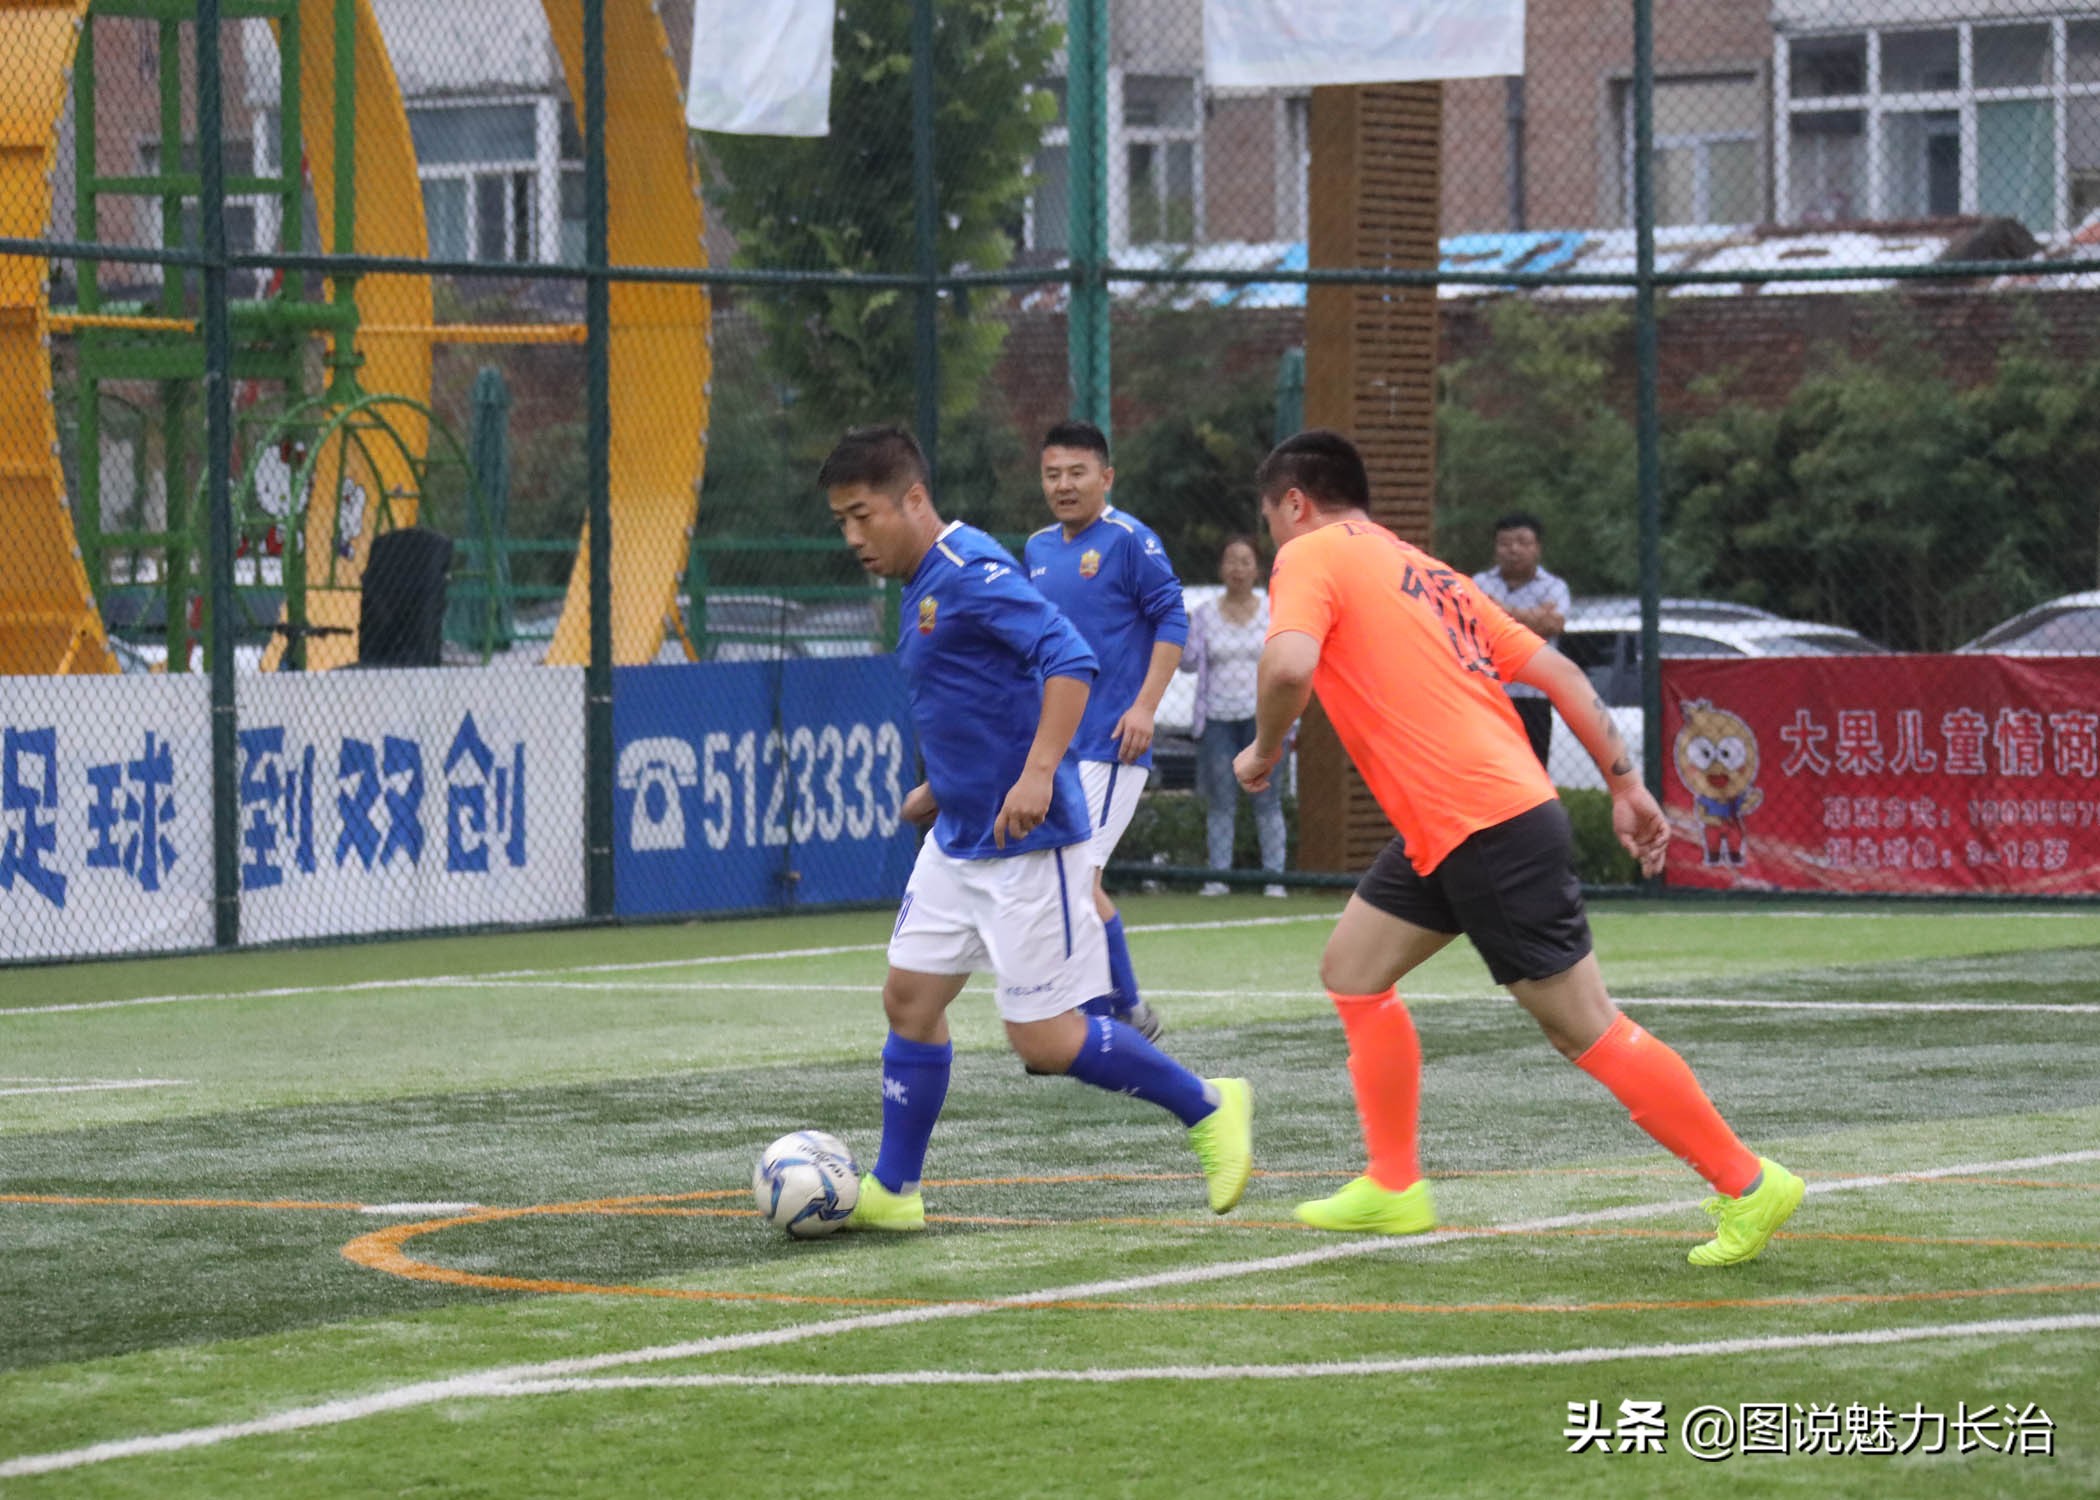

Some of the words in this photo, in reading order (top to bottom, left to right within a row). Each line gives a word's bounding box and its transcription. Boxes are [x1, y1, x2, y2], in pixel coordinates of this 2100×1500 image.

[703, 721, 903, 851] 5123333
[1779, 706, 2099, 778] 大果儿童情商
[0, 709, 526, 908] 足球到双创
